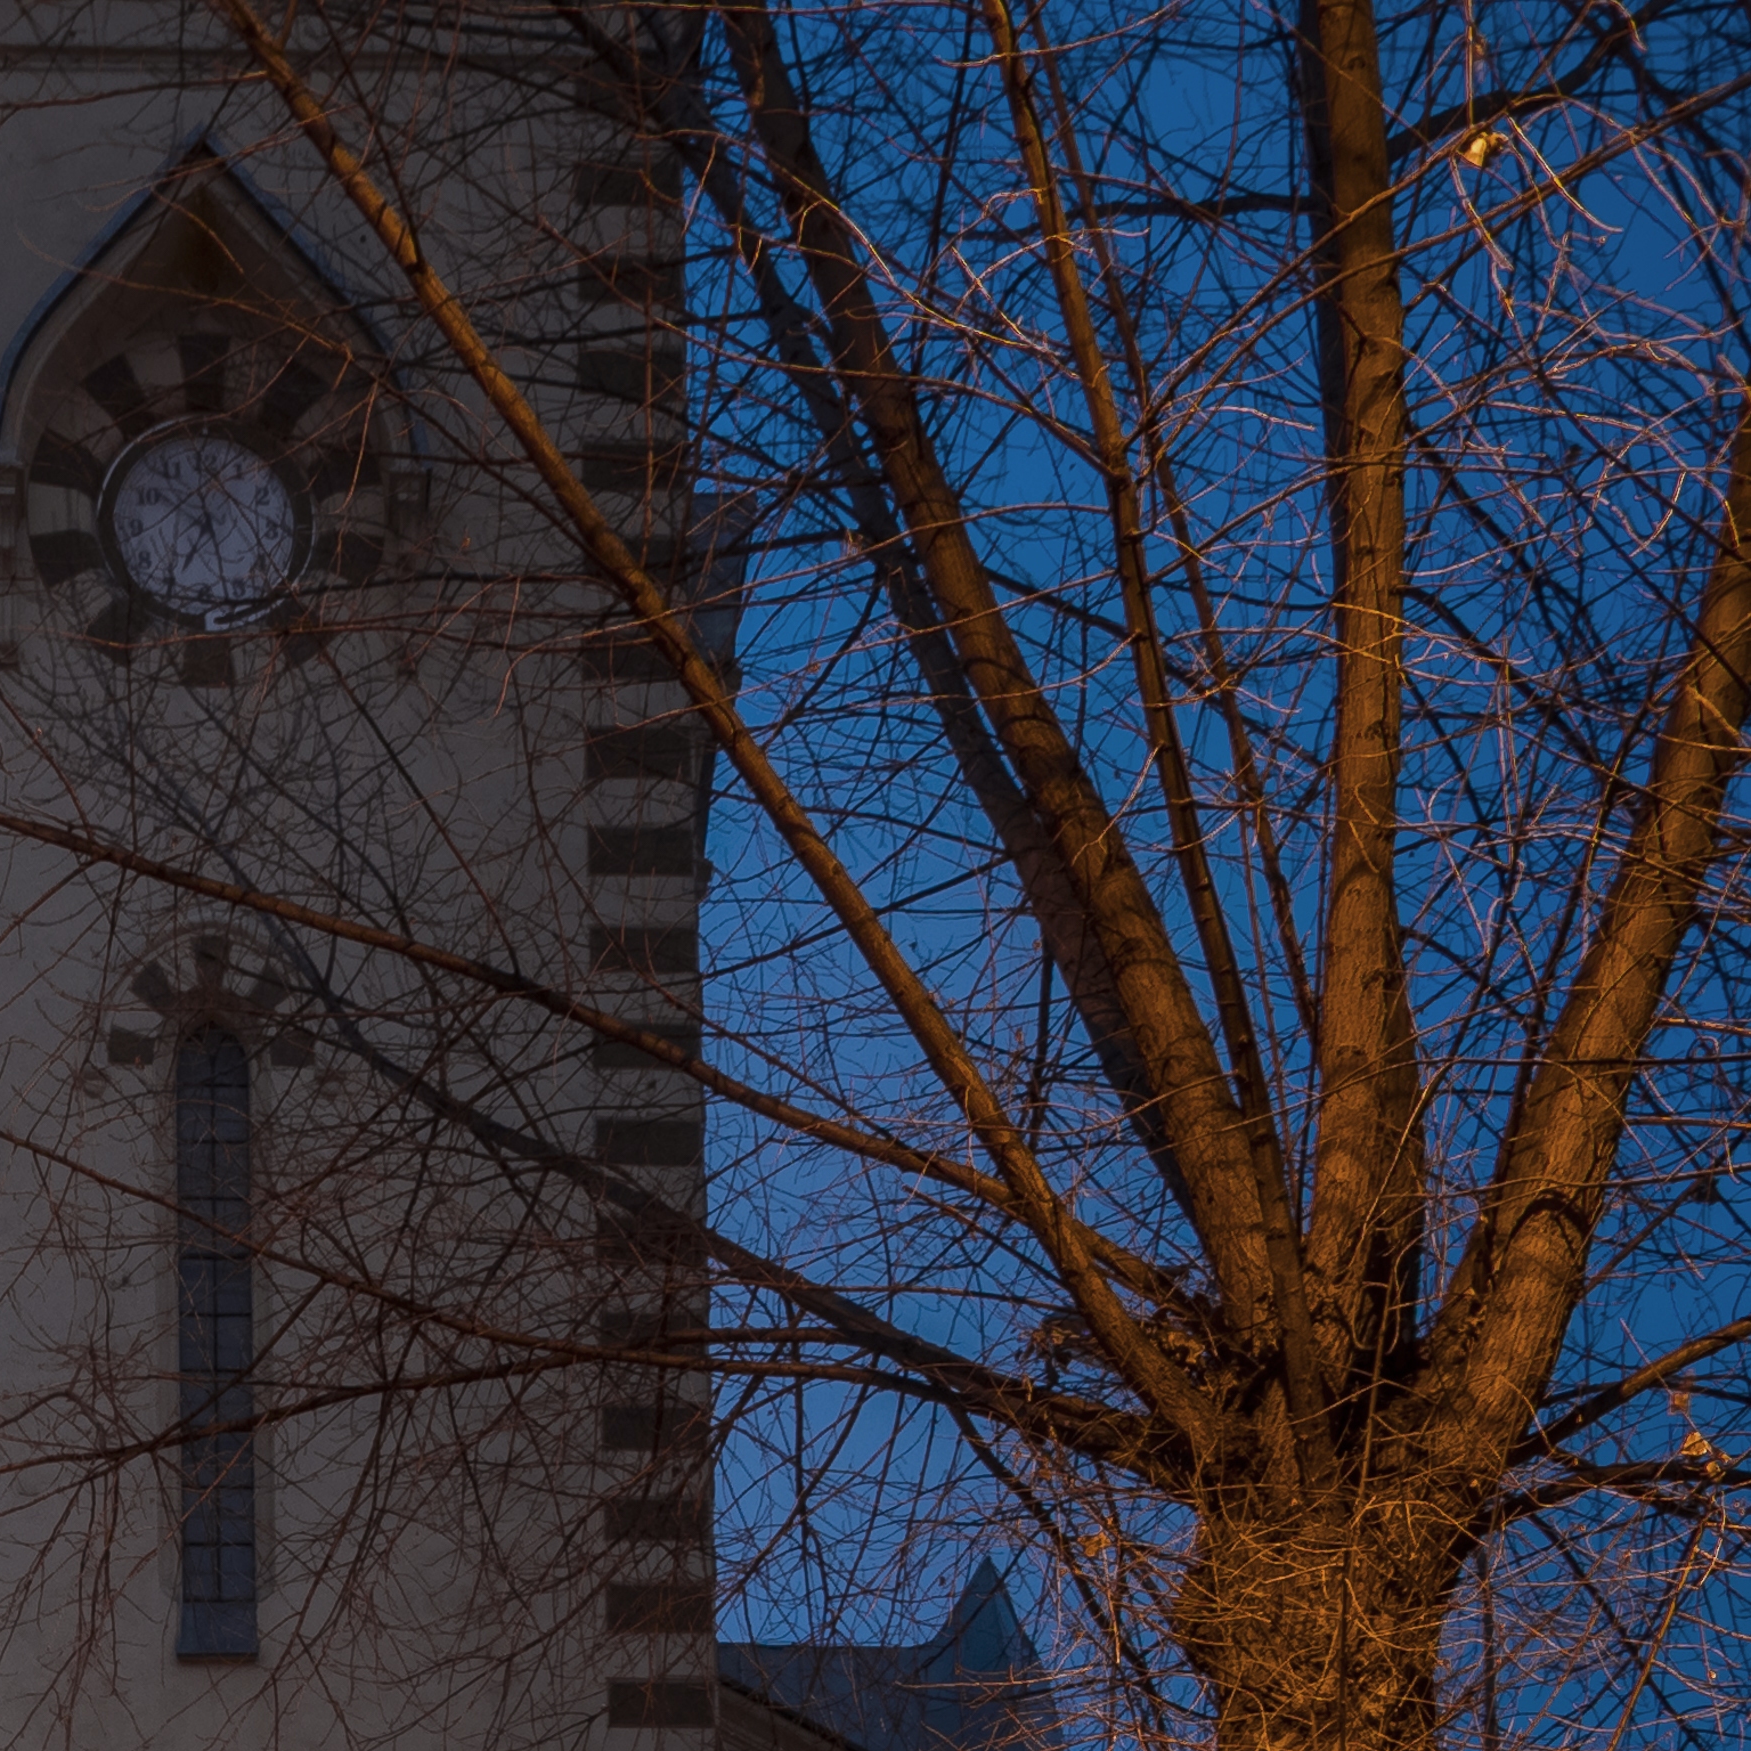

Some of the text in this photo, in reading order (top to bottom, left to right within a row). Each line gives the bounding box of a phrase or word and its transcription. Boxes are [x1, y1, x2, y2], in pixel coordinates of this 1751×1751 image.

[163, 458, 181, 479] 11
[233, 462, 245, 480] 1
[136, 486, 159, 507] 10
[256, 487, 270, 506] 2
[129, 519, 143, 538] 9
[138, 550, 152, 570] 8
